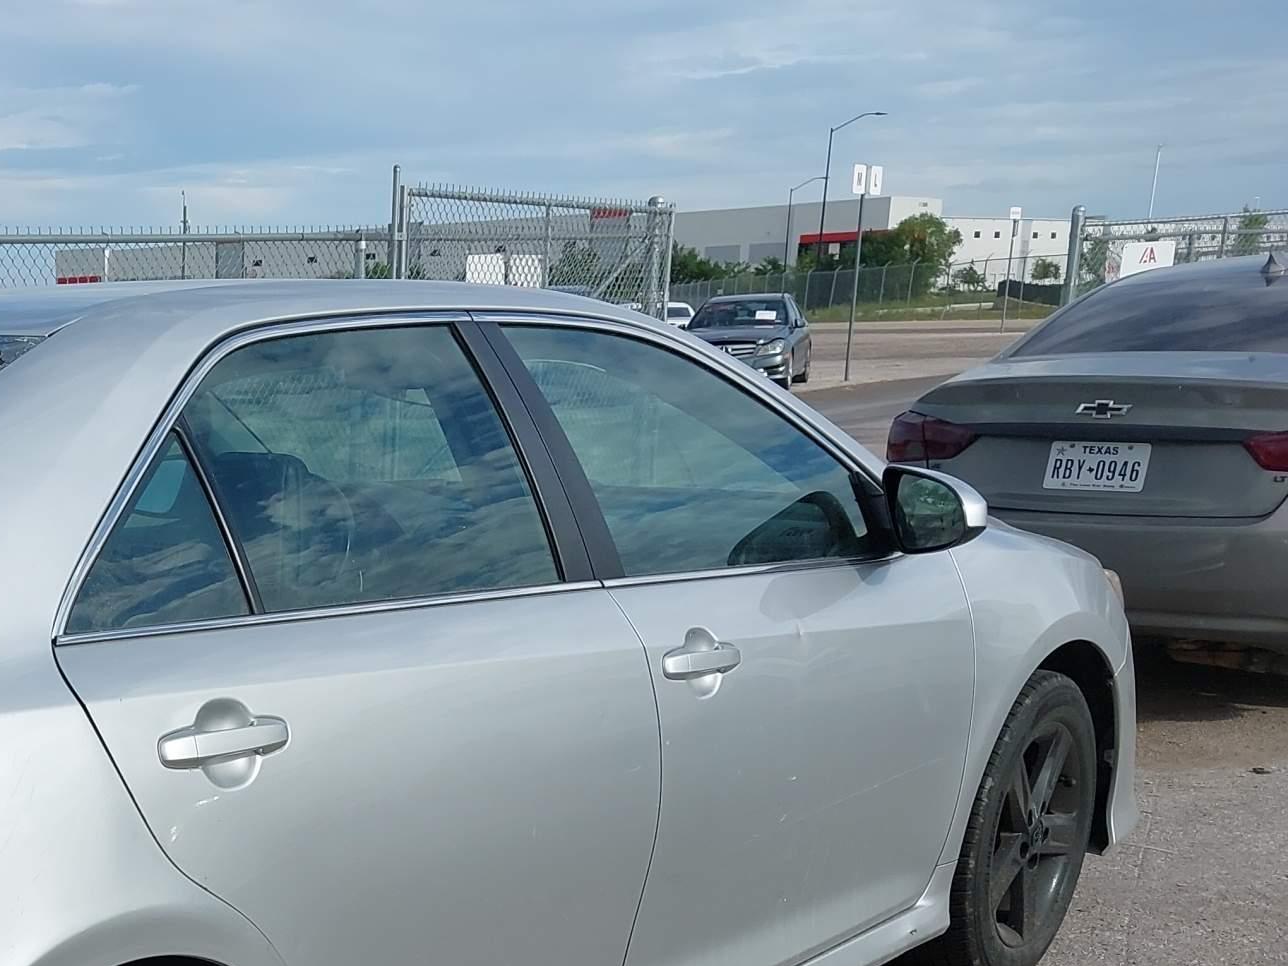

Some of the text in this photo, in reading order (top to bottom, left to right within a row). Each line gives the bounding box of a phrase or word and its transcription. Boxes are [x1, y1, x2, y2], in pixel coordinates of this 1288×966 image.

[1082, 445, 1120, 456] TEXAS
[1051, 458, 1142, 482] RBY 0946
